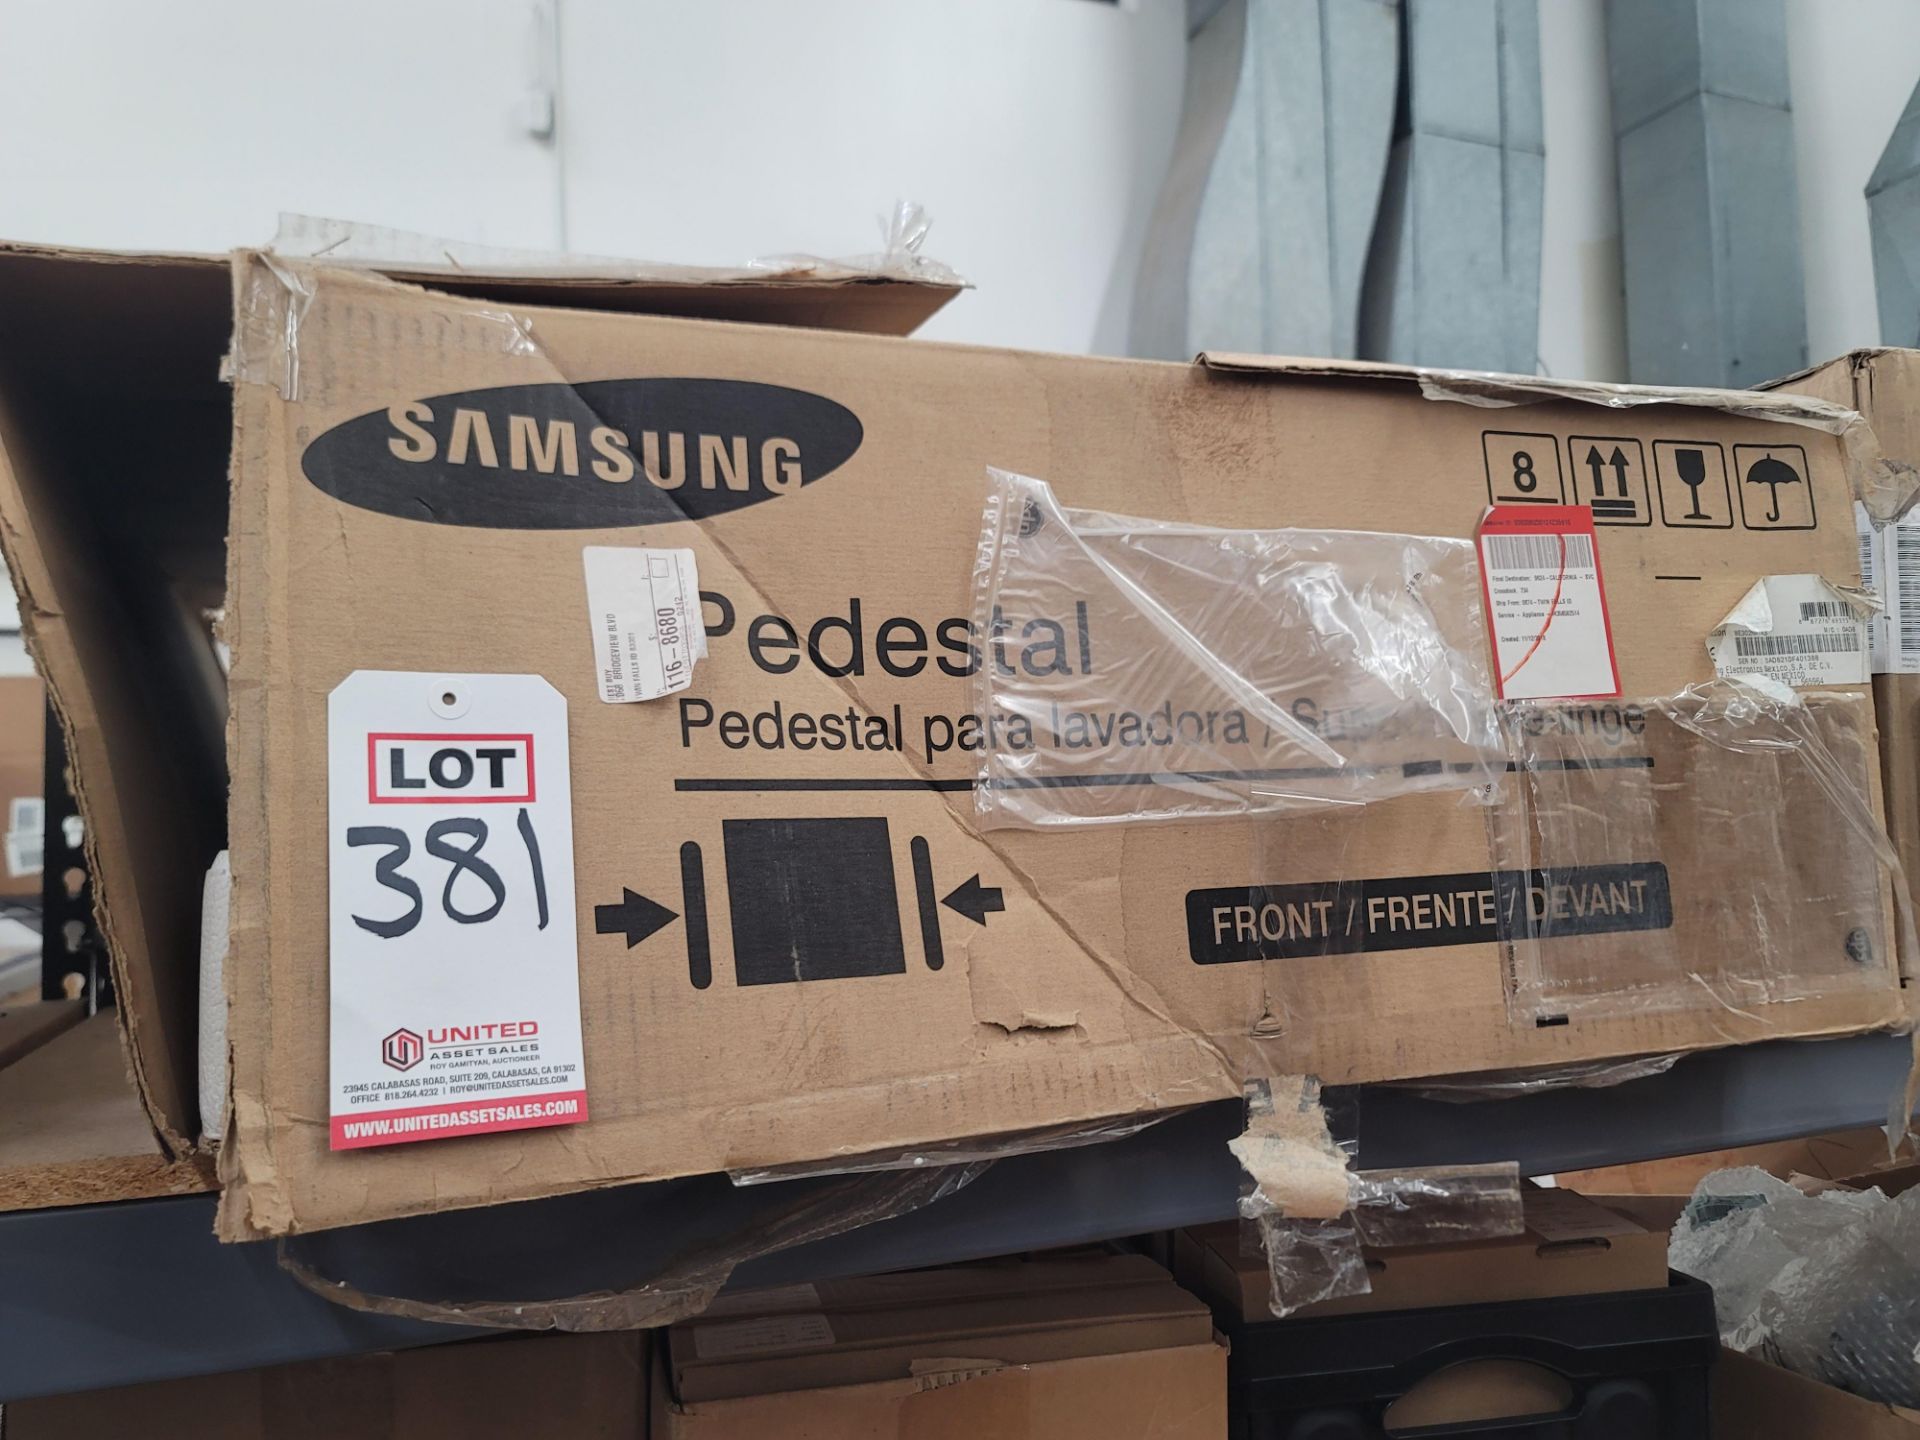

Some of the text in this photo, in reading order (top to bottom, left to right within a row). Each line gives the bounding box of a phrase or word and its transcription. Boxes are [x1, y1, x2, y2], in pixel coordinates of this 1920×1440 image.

[387, 401, 804, 497] SAMSUNG
[1512, 451, 1537, 493] 8
[606, 613, 618, 633] BLVD
[699, 591, 1093, 678] Pedestal
[609, 634, 622, 680] BRIDGEVIEW
[1725, 665, 1763, 674] Electronics
[678, 697, 903, 752] Pedestal
[923, 711, 1035, 764] para
[1052, 700, 1249, 749] lavadora
[389, 747, 517, 789] LOT
[346, 807, 549, 940] 381
[1212, 899, 1333, 946] FRONT
[1368, 888, 1498, 934] FRENTE
[1526, 879, 1648, 922] DEVANT
[428, 1021, 539, 1044] UNITED
[430, 1043, 540, 1060] ASSET SALES
[343, 1063, 577, 1094] 23945 CALABASAS ROAD, SUITE 209, CALABASAS, CA 91302
[430, 1054, 541, 1071] ROY GAMITYAN, AUCTIONEER
[350, 1093, 381, 1105] OFFICE
[384, 1087, 440, 1102] 818.264.4232
[449, 1074, 570, 1095] ROY@UNITEDASSETSALES.COM
[343, 1098, 578, 1139] WWW.UNITEDASSETSALES.COM
